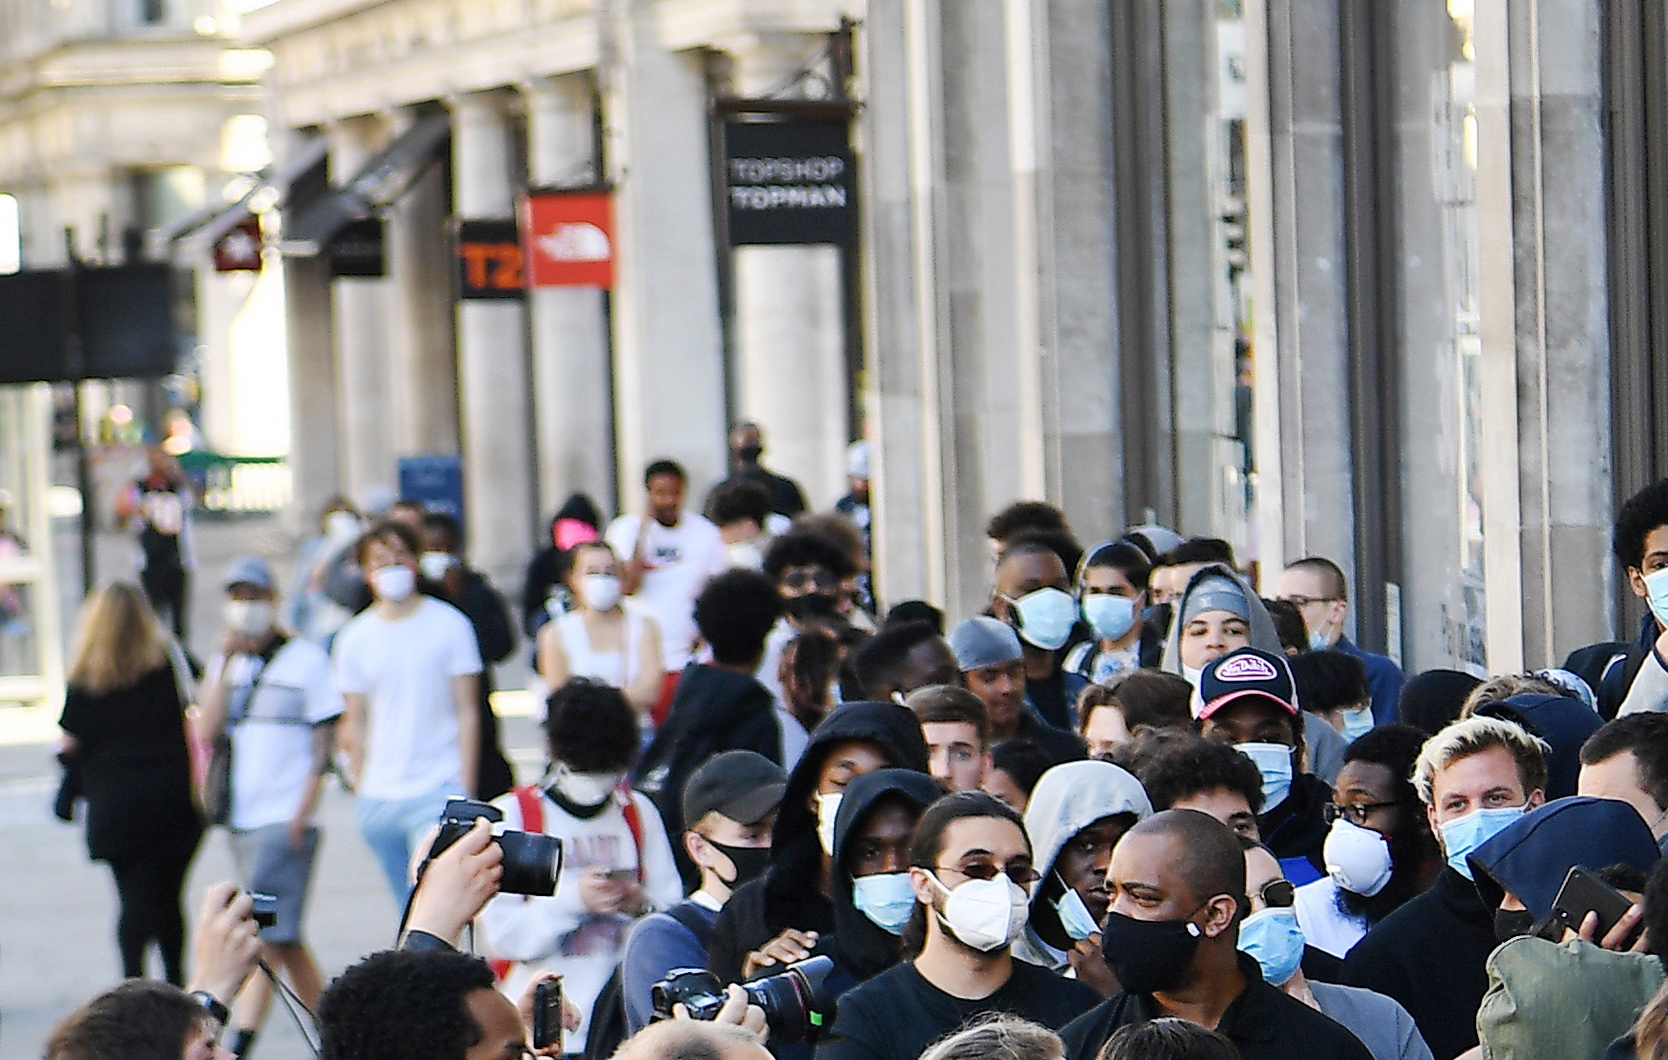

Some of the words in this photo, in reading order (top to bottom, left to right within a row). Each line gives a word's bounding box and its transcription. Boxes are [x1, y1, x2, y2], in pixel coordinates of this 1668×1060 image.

[730, 156, 845, 181] TOPSHOP
[732, 185, 847, 209] TOPMAN
[461, 241, 524, 290] T2
